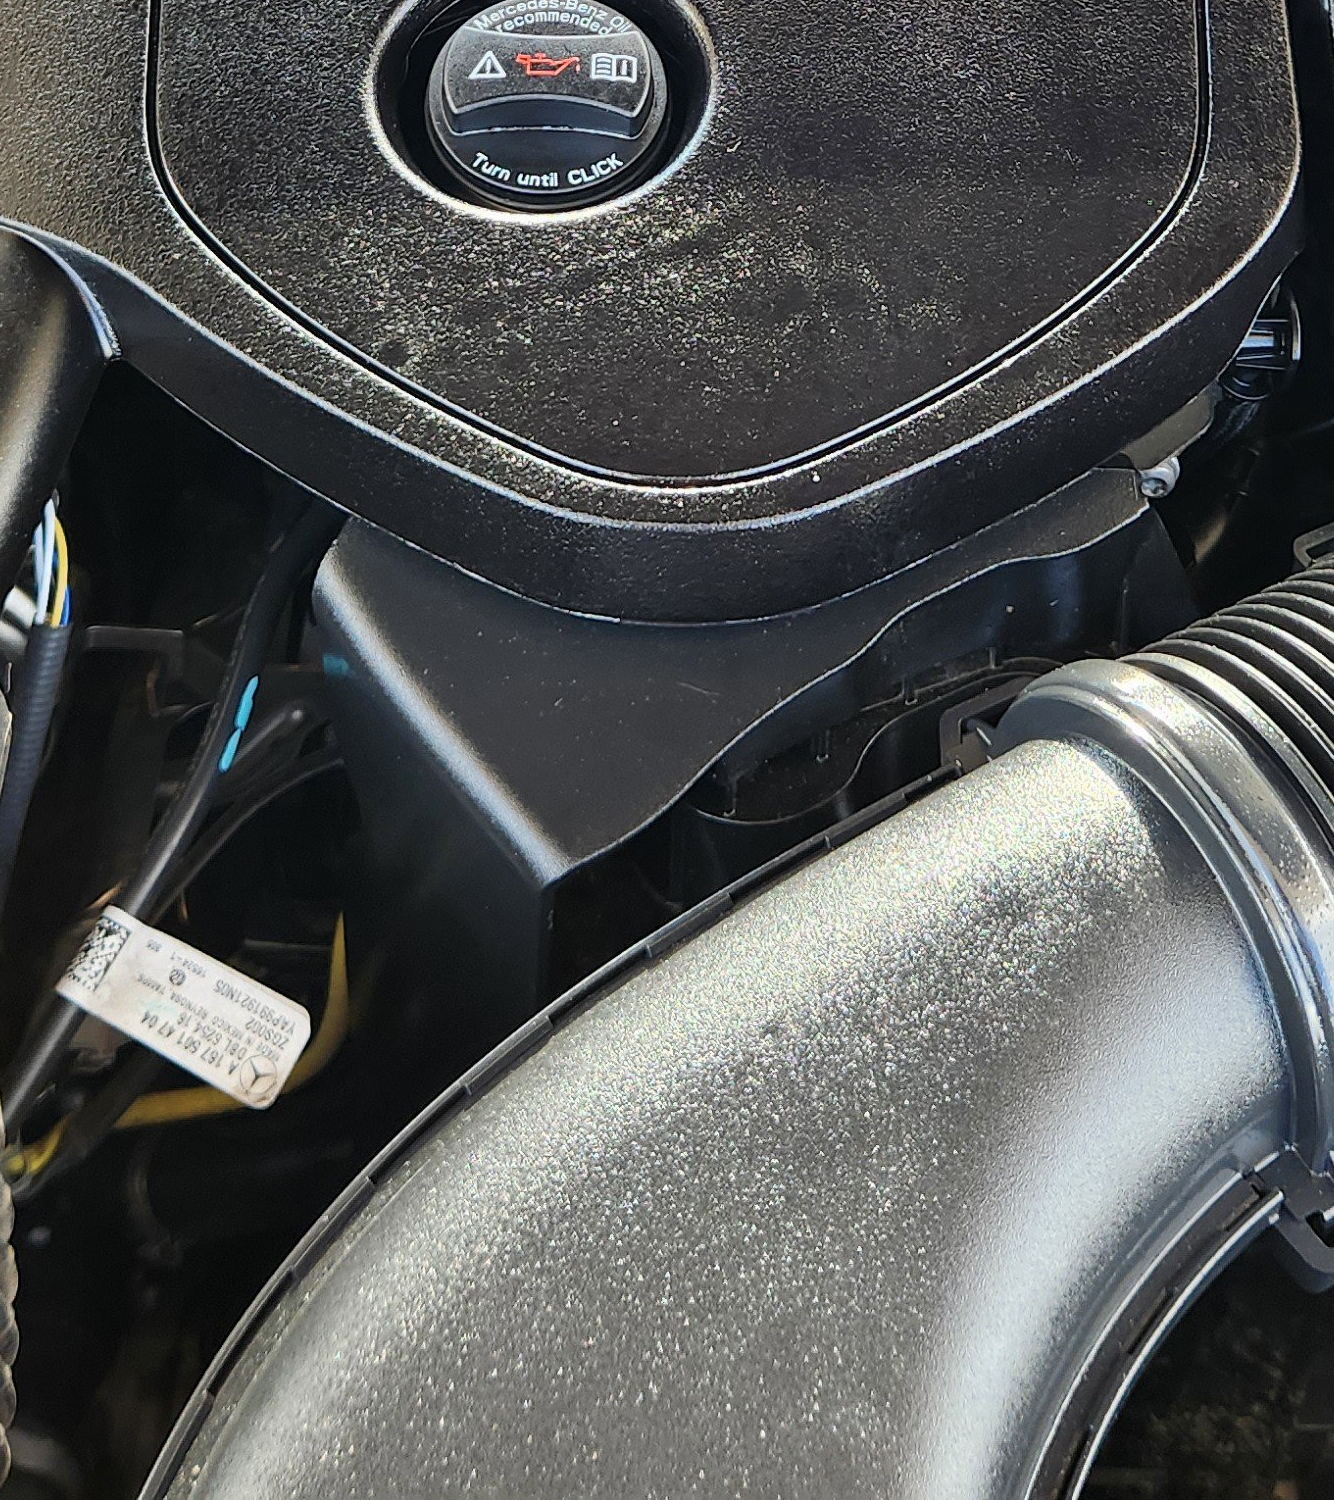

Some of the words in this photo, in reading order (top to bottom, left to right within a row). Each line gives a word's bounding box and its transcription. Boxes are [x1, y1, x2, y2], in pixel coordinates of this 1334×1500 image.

[496, 11, 614, 35] recommended
[610, 17, 632, 33] Oil
[472, 152, 510, 181] Turn
[516, 172, 559, 188] until
[567, 153, 624, 185] CLICK
[139, 1010, 159, 1029] 04
[158, 1020, 177, 1039] 47
[210, 1015, 244, 1039] MEXICO
[176, 1031, 202, 1053] 501
[199, 1044, 225, 1067] 167
[225, 1060, 239, 1076] A
